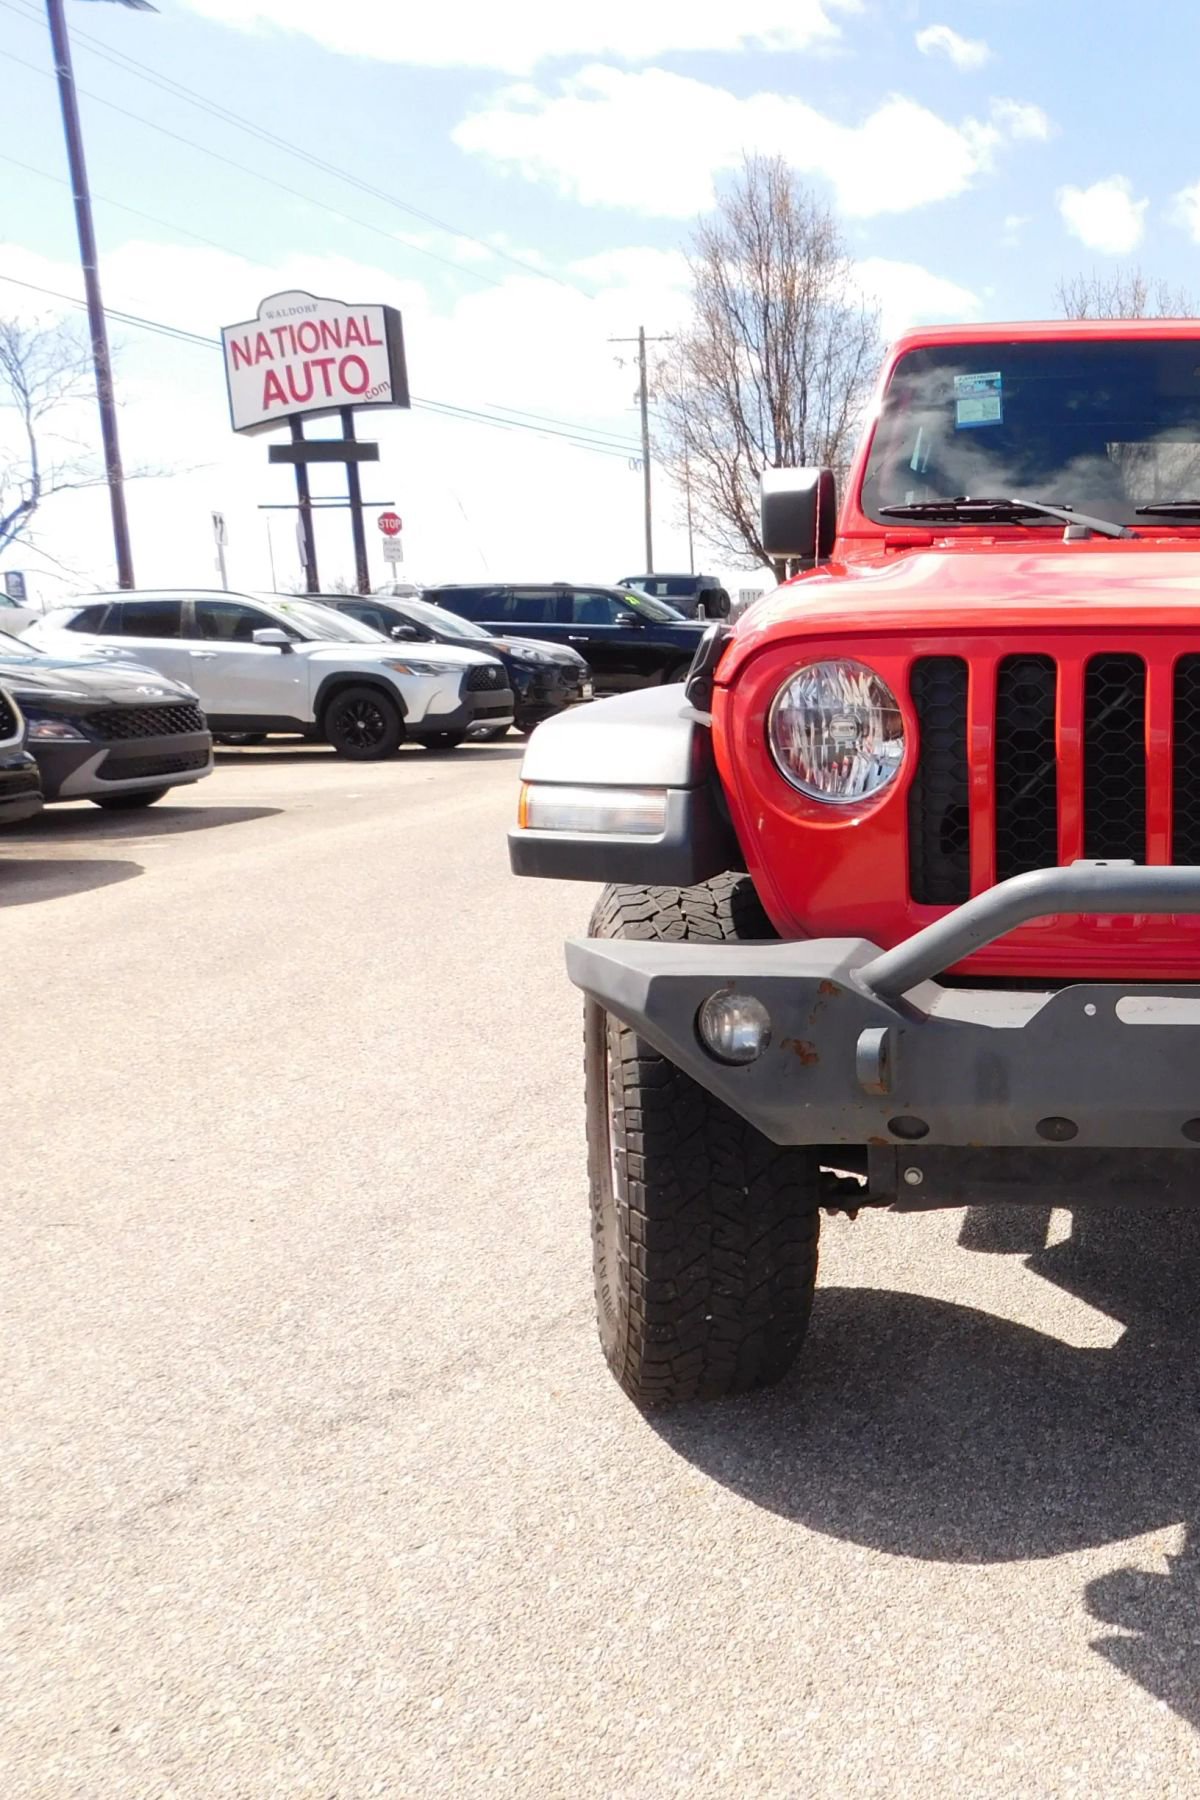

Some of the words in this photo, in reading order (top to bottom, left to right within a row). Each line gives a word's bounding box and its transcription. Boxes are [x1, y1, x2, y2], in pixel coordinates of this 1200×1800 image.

[230, 315, 383, 370] NATIONAL
[262, 355, 370, 410] AUTO
[364, 380, 391, 402] .com
[379, 518, 401, 529] STOP
